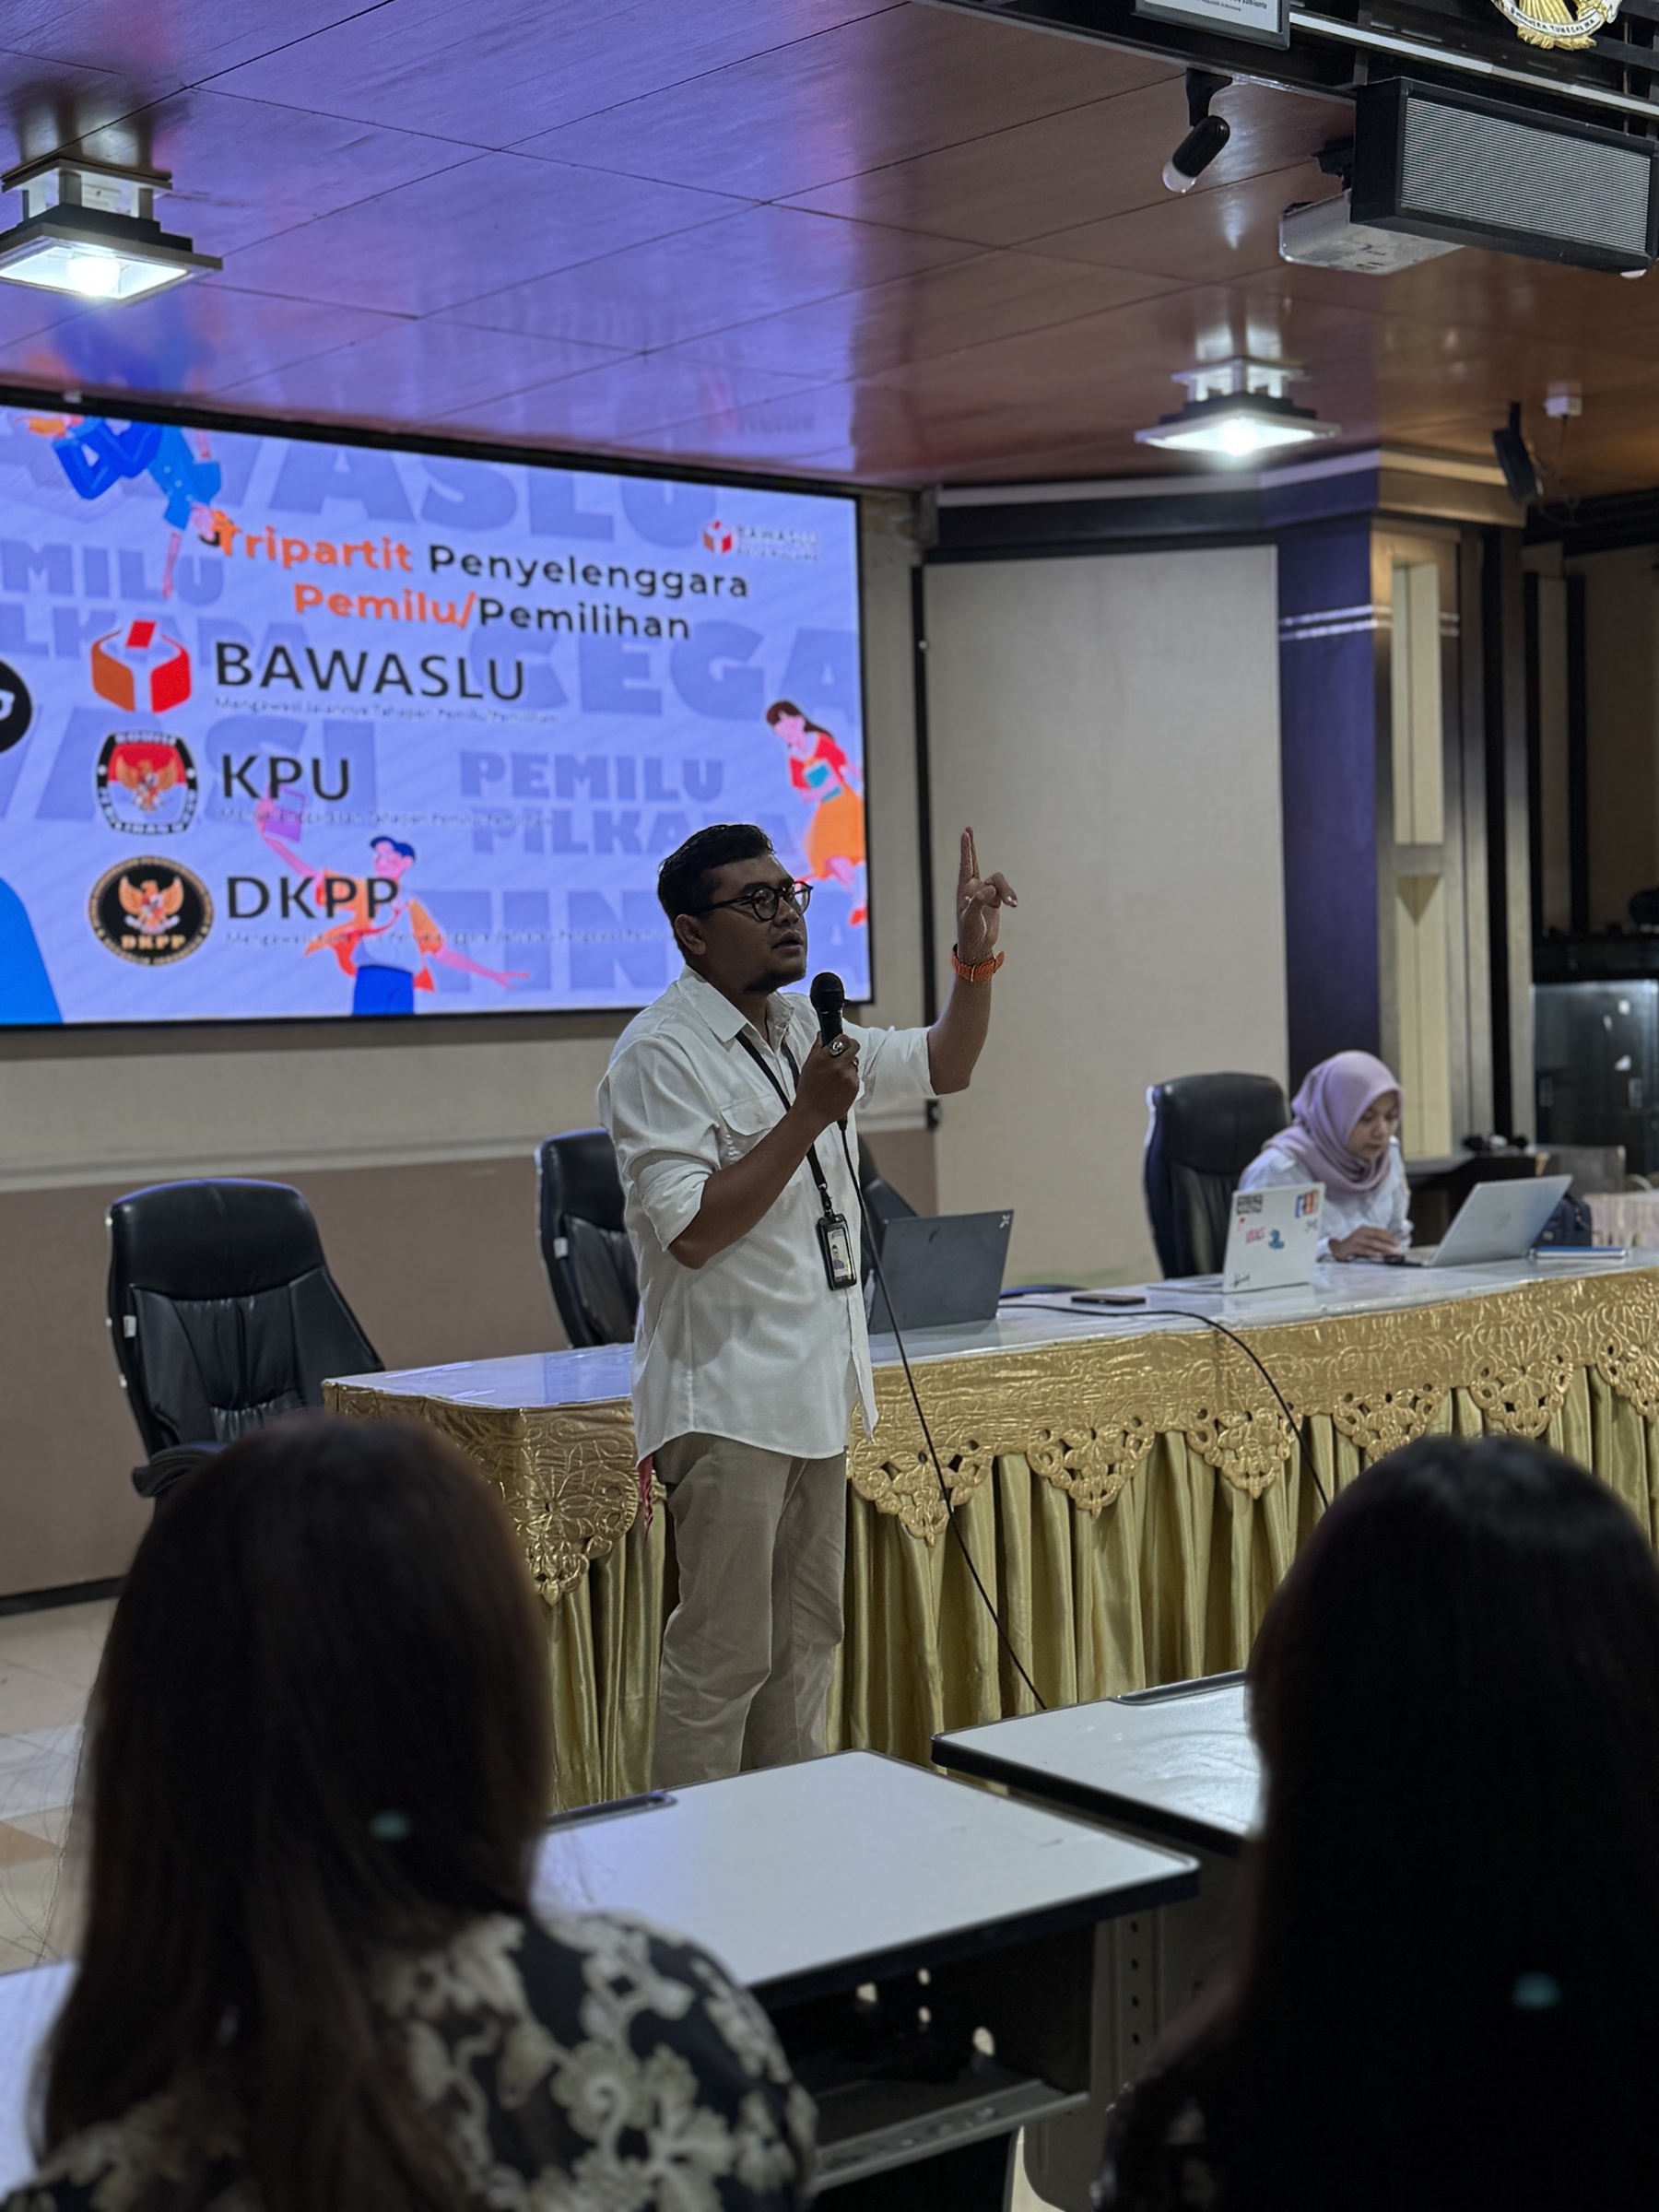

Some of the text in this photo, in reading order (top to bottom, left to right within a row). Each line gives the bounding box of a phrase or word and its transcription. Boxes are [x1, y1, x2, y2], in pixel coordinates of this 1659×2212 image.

[212, 520, 748, 598] Tripartit Penyelenggara
[215, 641, 524, 701] BAWASLU
[222, 753, 350, 801] KPU
[459, 749, 724, 803] PEMILU
[227, 876, 399, 920] DKPP
